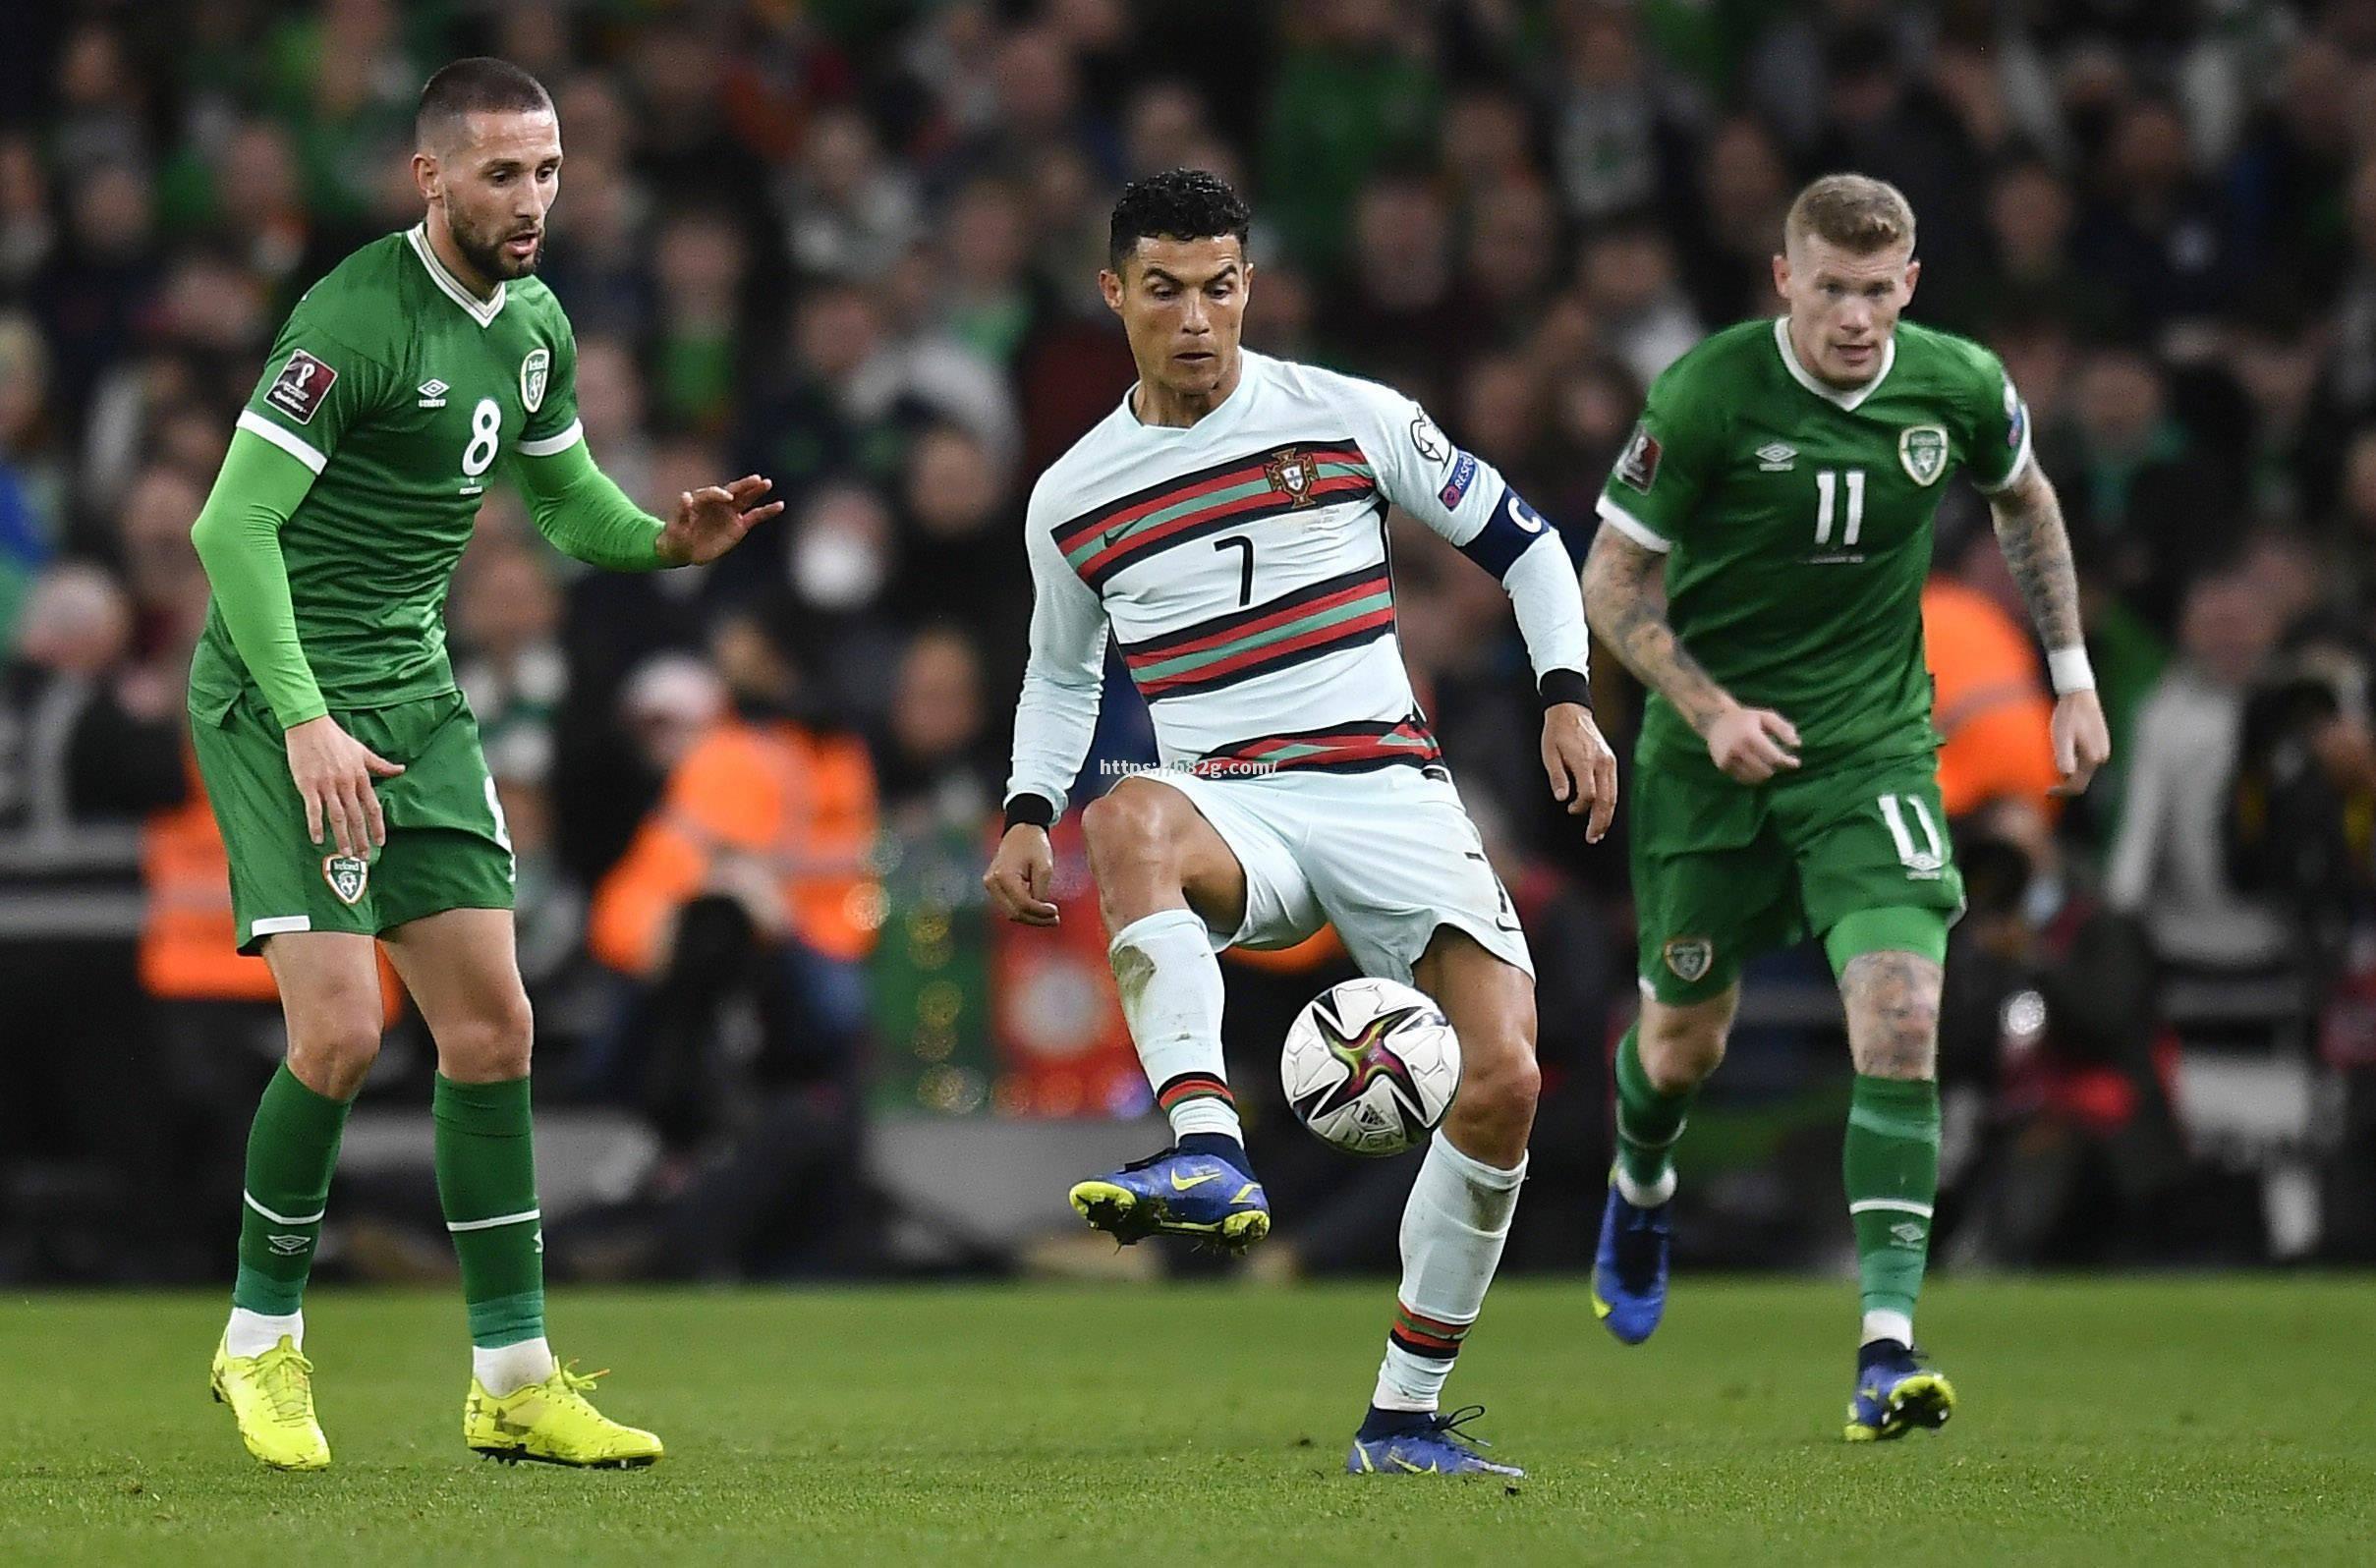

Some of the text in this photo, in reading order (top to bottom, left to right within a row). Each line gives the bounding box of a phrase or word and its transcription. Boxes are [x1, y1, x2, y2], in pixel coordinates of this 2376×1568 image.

[462, 398, 501, 476] 8
[1507, 496, 1542, 533] C
[1814, 472, 1866, 545] 11
[1213, 534, 1254, 607] 7
[1878, 794, 1942, 865] 11
